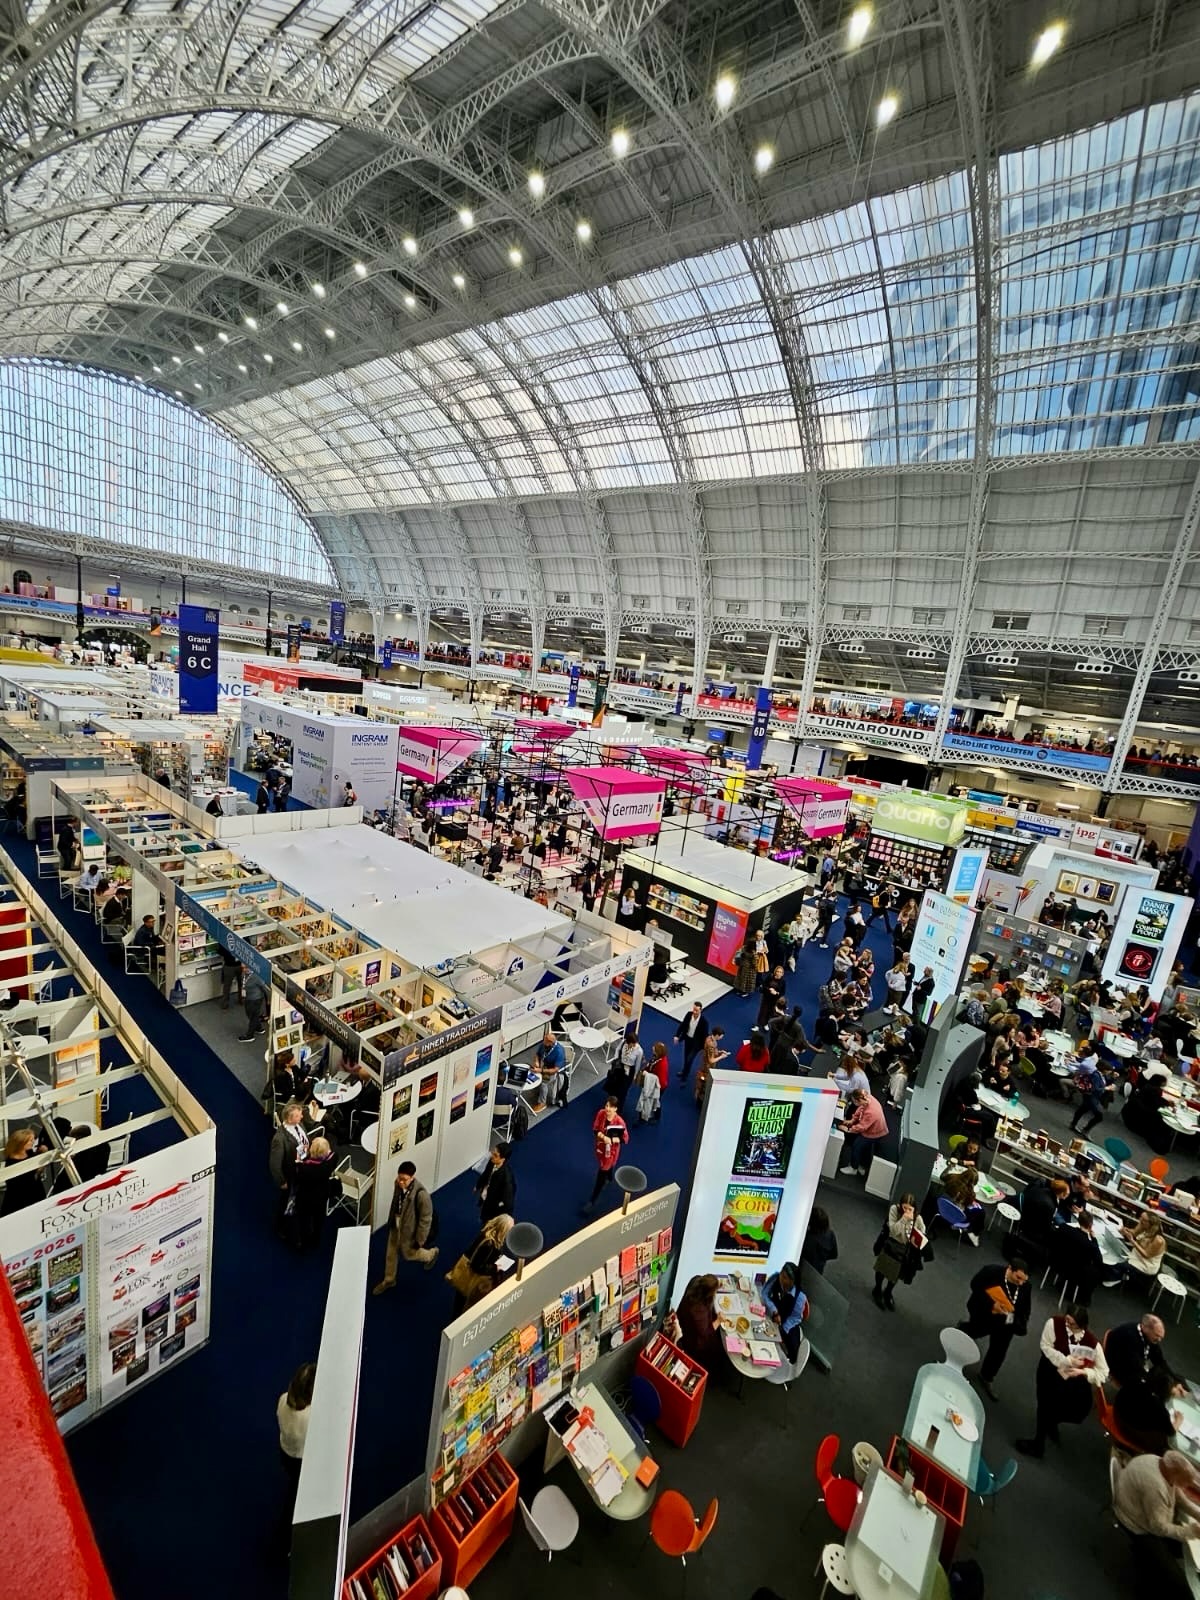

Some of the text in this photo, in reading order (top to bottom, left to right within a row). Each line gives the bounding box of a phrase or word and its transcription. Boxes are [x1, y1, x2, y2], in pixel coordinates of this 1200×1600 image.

[187, 635, 211, 644] Grand
[303, 725, 325, 738] INGRAM
[817, 716, 925, 741] TURNAROUND
[352, 734, 389, 743] INGRAM
[951, 738, 1034, 757] READ LIKE YOU LISTEN
[400, 744, 430, 767] Germany
[612, 803, 654, 817] Germany
[818, 808, 842, 820] Germany
[1076, 826, 1098, 840] ipg
[1141, 905, 1168, 915] MASON
[1143, 900, 1169, 910] DANIEL
[715, 921, 727, 931] List
[717, 914, 737, 928] Rights
[1135, 923, 1162, 934] COUNTRY
[1136, 929, 1158, 938] PEOPLE
[421, 1035, 445, 1053] INNER
[446, 1016, 488, 1041] TRADITIONS
[748, 1104, 793, 1121] ALL HAIL
[751, 1119, 784, 1136] CHAOS
[728, 1189, 761, 1198] KENNEDY
[761, 1191, 779, 1199] RYAN
[40, 1177, 150, 1234] FOX CHAPEL
[727, 1199, 775, 1213] SCORE
[45, 1190, 145, 1239] PUBLISHING
[4, 1233, 77, 1273] for 2026
[478, 1289, 524, 1331] hachette
